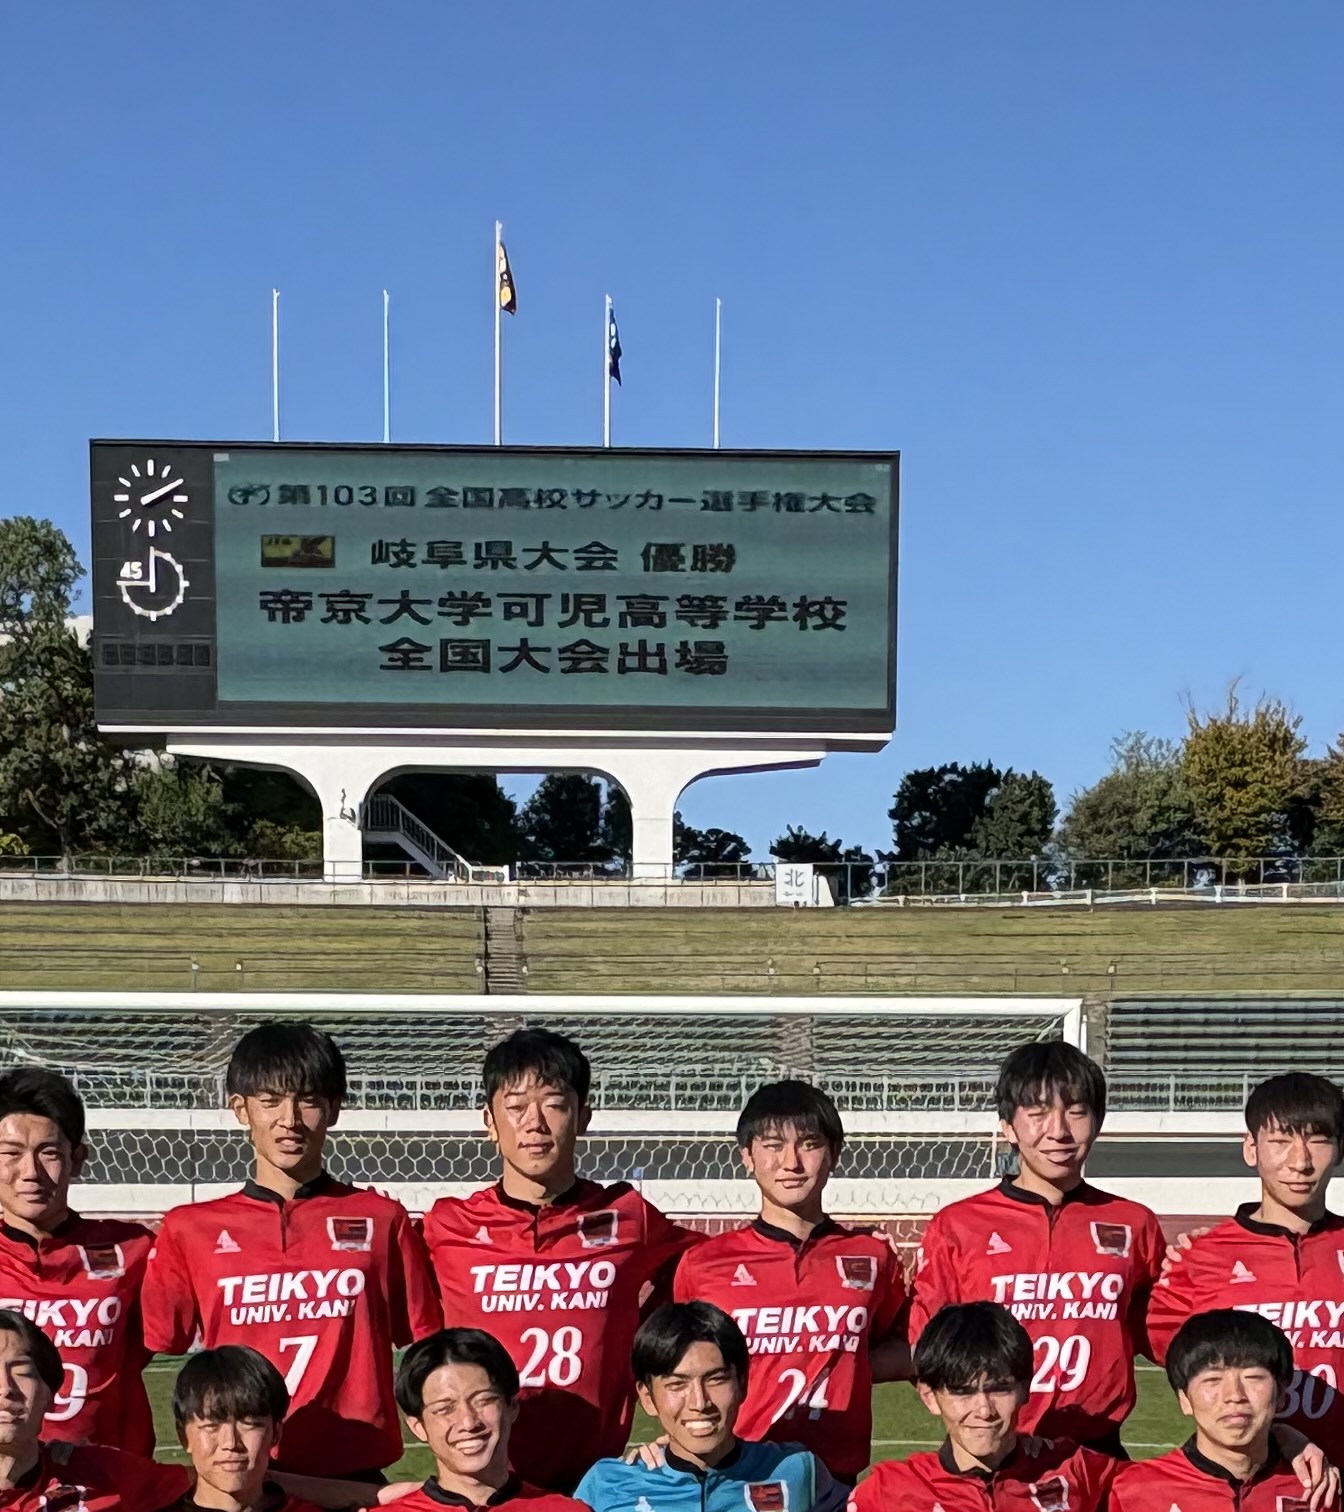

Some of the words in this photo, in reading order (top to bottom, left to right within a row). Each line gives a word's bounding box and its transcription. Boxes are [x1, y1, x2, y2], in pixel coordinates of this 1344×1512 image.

[371, 537, 618, 571] 岐阜県大会
[641, 541, 737, 573] 優勝
[259, 588, 848, 631] 帝京大学可児高等学校
[378, 637, 729, 676] 全国大会出場
[218, 1269, 365, 1304] TEIKYO
[470, 1261, 616, 1292] TEIKYO
[991, 1271, 1124, 1300] TEIKYO
[231, 1306, 293, 1325] UNIV.
[299, 1300, 355, 1320] KANI
[482, 1294, 543, 1312] UNIV.
[551, 1291, 609, 1308] KANI
[735, 1305, 868, 1333] TEIKYO
[1063, 1302, 1118, 1320] KANI
[519, 1326, 583, 1388] 28
[812, 1335, 860, 1353] KANI
[279, 1335, 319, 1395] 7
[1032, 1335, 1091, 1393] 29
[771, 1368, 829, 1423] 24
